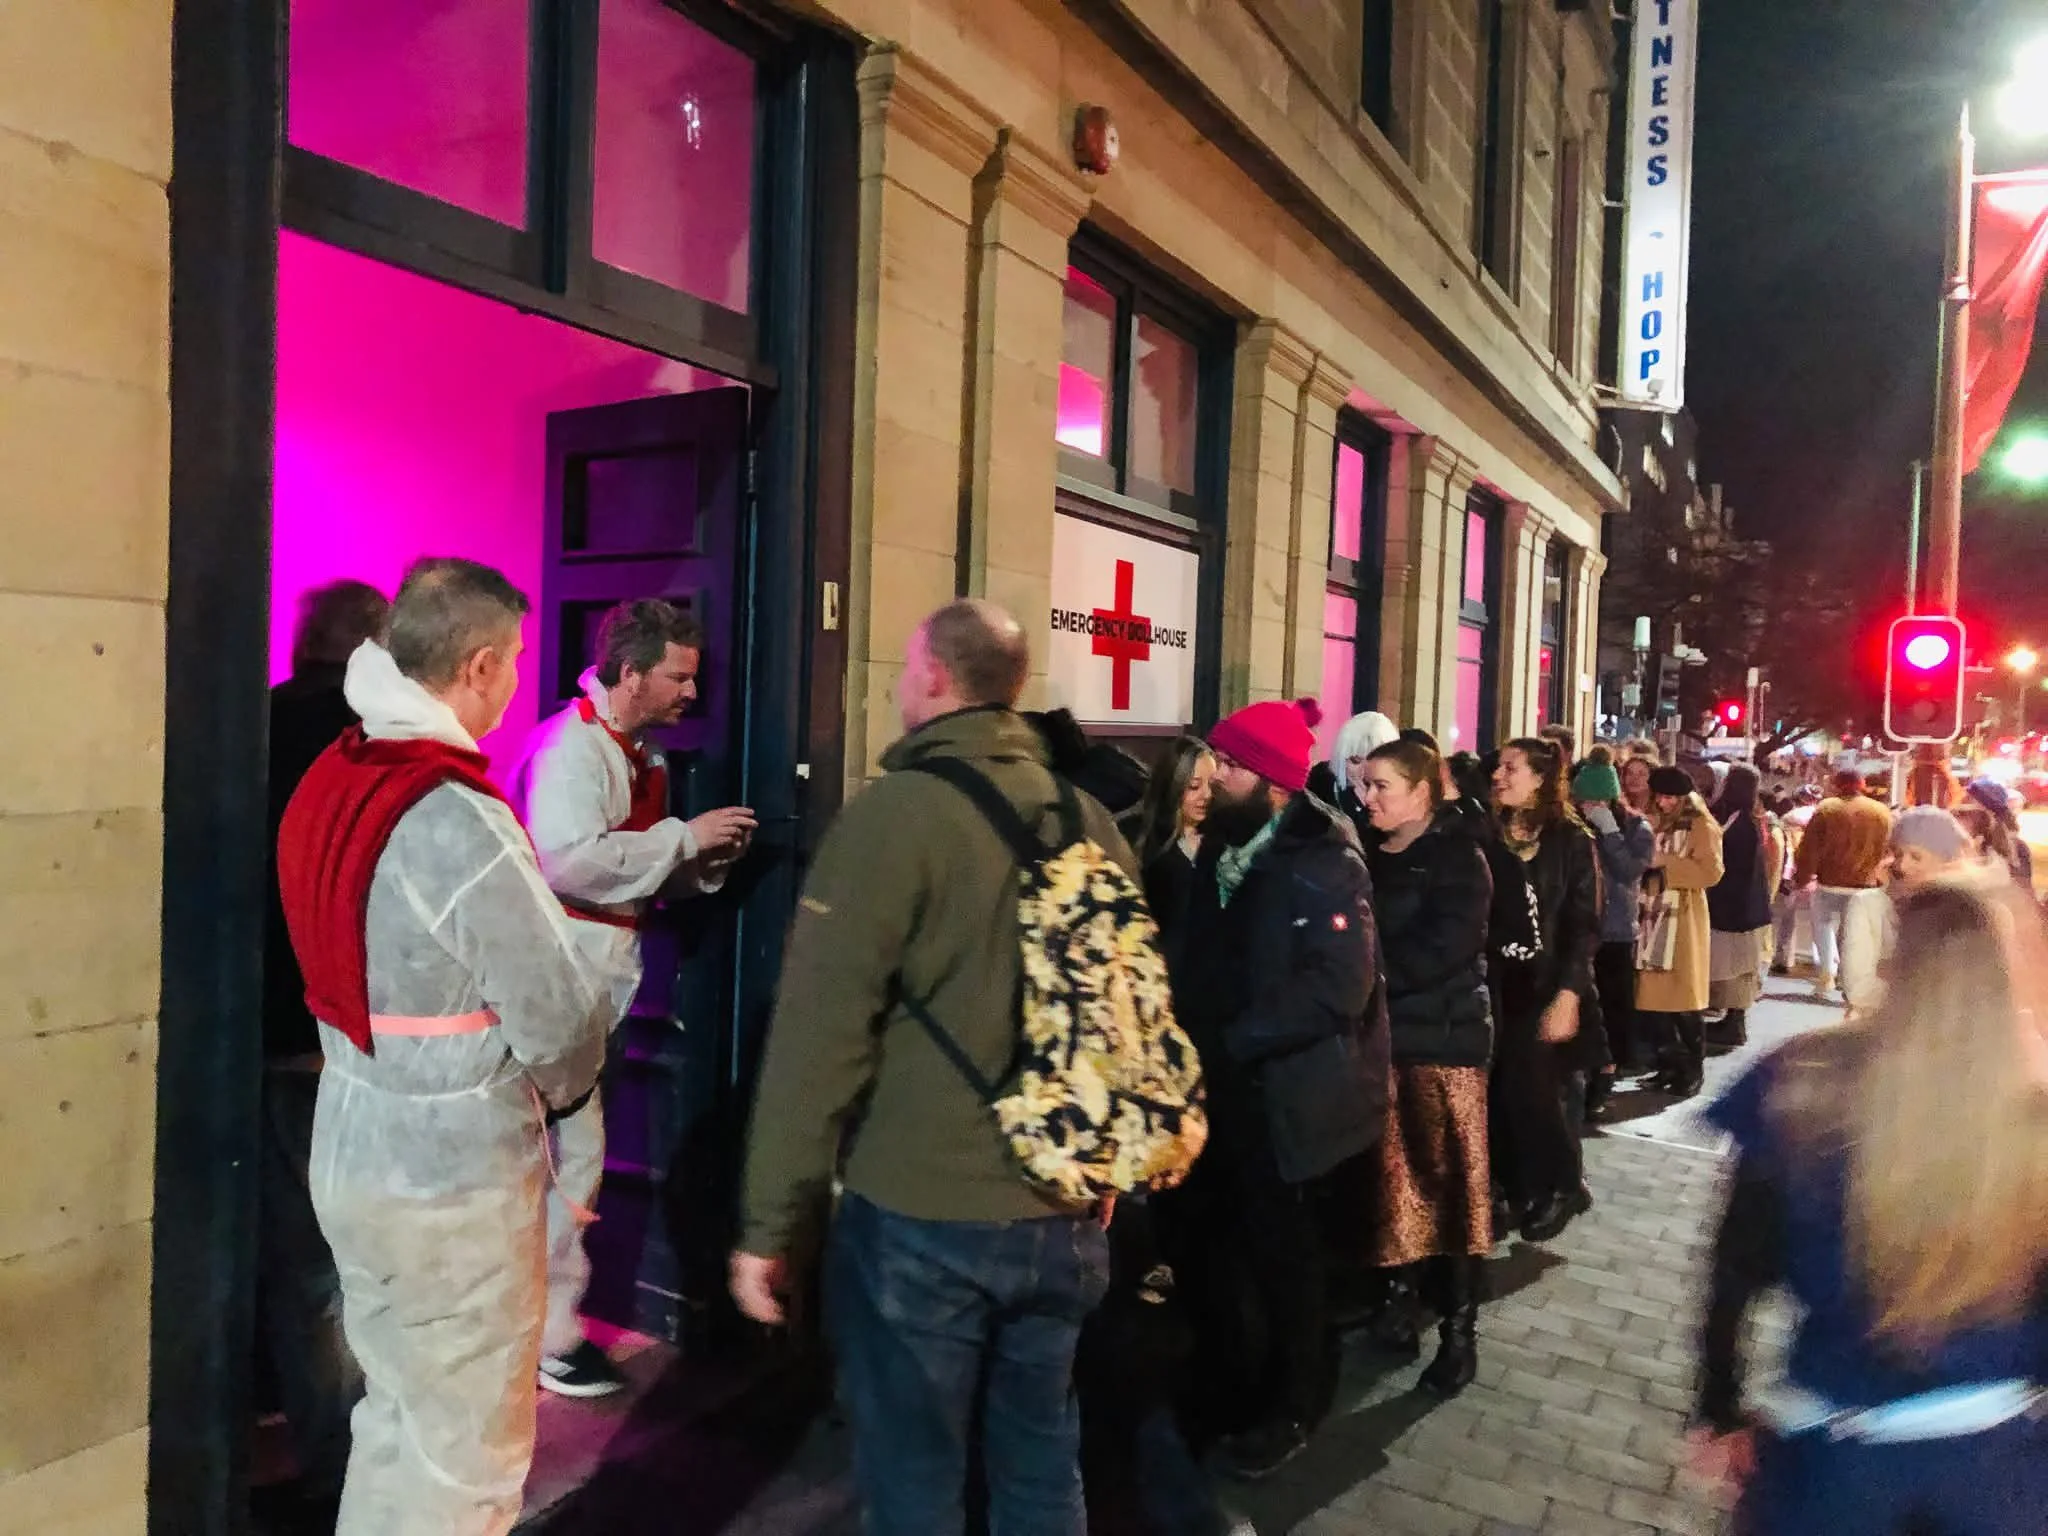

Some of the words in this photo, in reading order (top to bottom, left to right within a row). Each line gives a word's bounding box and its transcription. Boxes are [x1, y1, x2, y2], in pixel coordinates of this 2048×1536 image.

[1640, 271, 1664, 381] HOP
[1051, 608, 1126, 640] EMERGENCY
[1127, 621, 1187, 648] DOLLHOUSE
